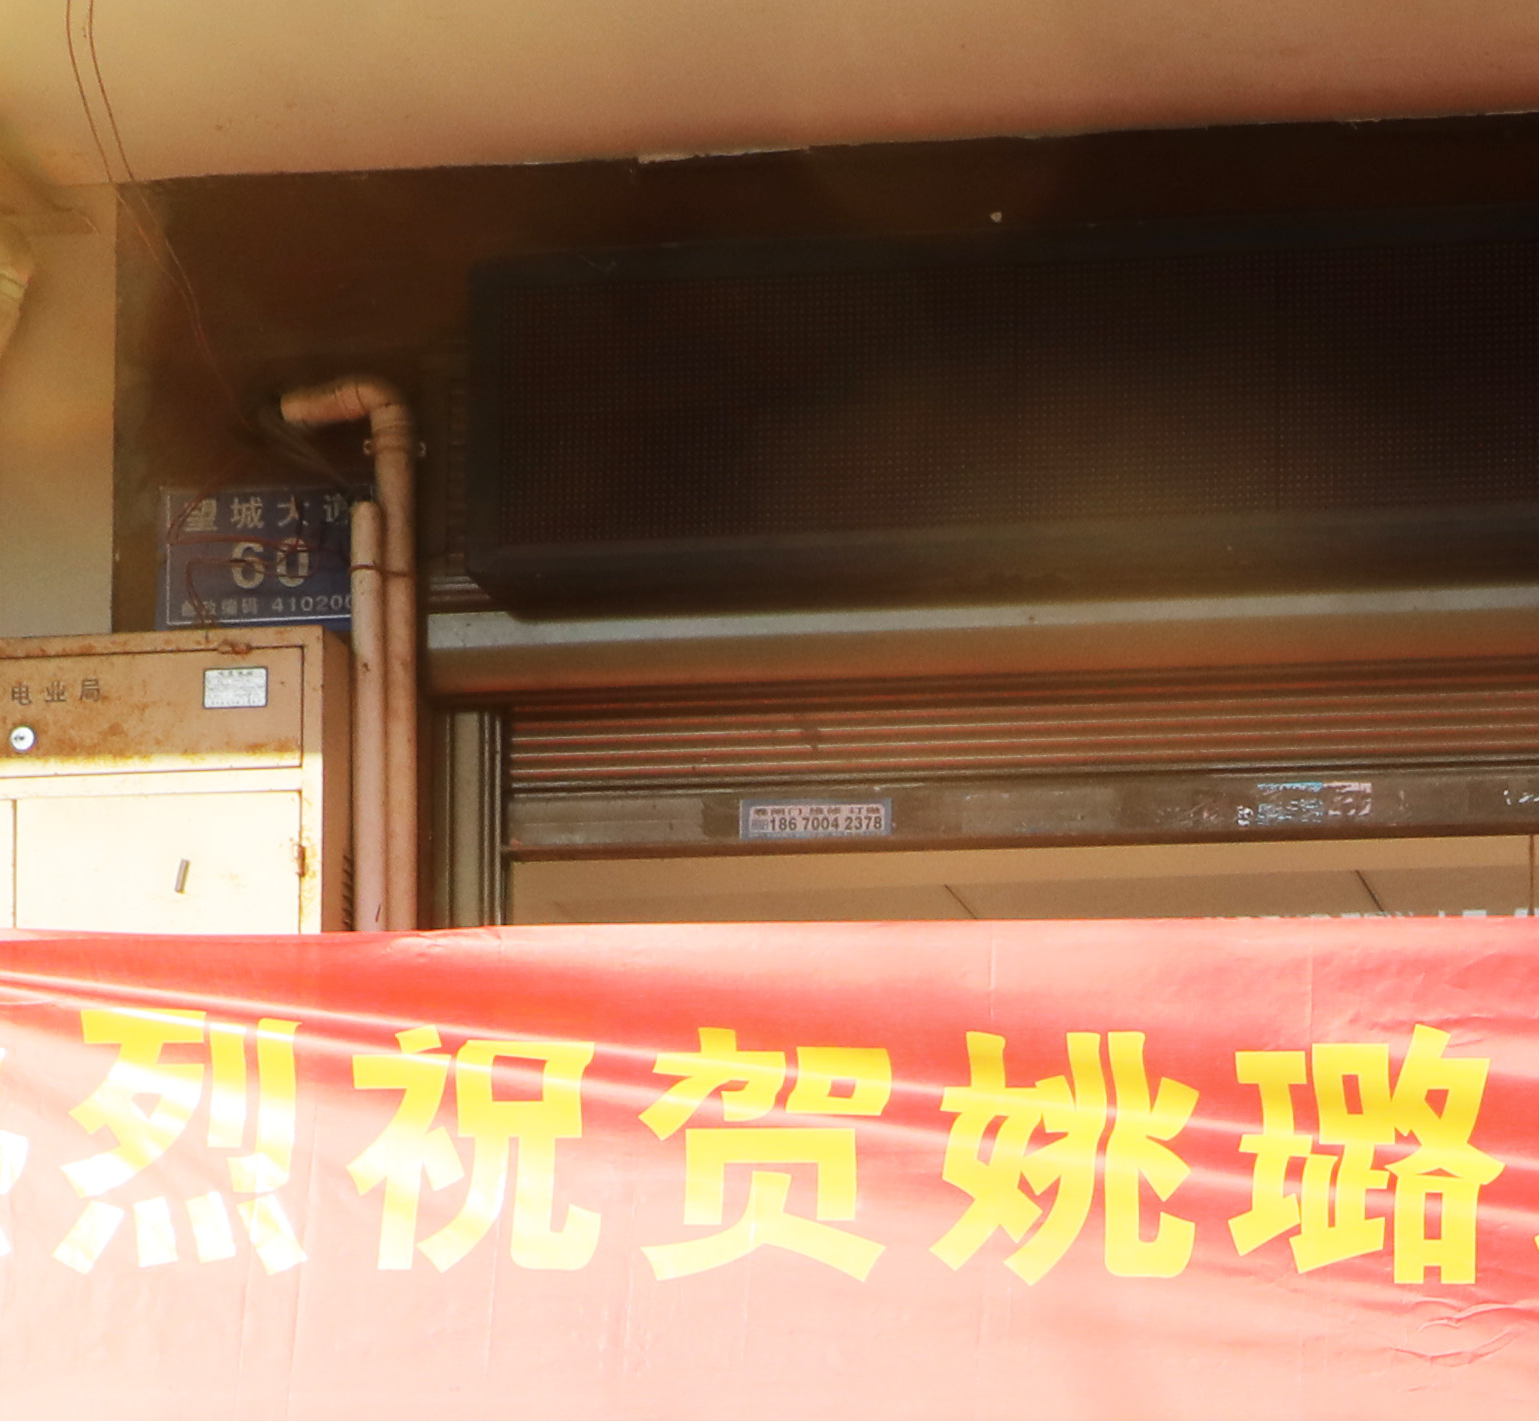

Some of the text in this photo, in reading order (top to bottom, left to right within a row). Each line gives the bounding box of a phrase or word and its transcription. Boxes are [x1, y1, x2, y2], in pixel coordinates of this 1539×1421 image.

[183, 494, 349, 532] 望城大道
[230, 537, 309, 590] 60
[770, 816, 882, 831] 186 7004 2378
